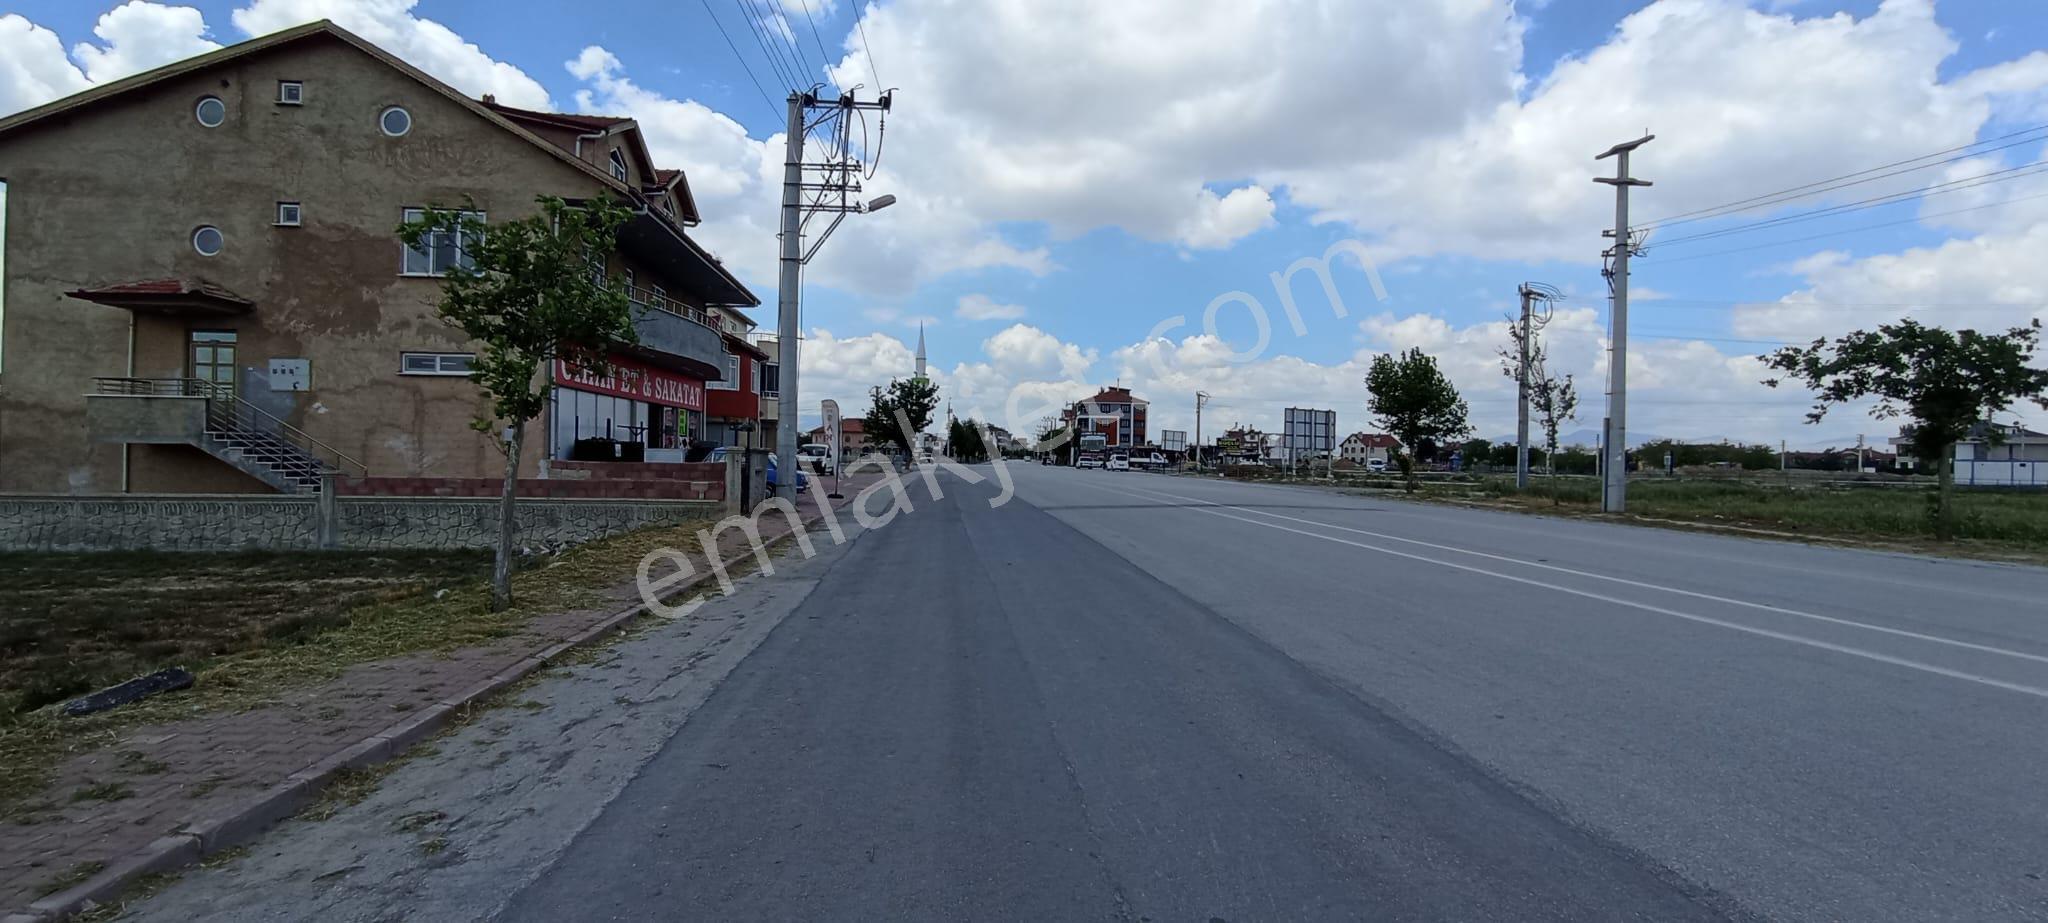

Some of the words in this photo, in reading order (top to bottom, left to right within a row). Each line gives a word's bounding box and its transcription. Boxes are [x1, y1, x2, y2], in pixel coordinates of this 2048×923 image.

[621, 367, 640, 395] ET
[643, 374, 652, 398] &
[656, 377, 701, 407] SAKATAT
